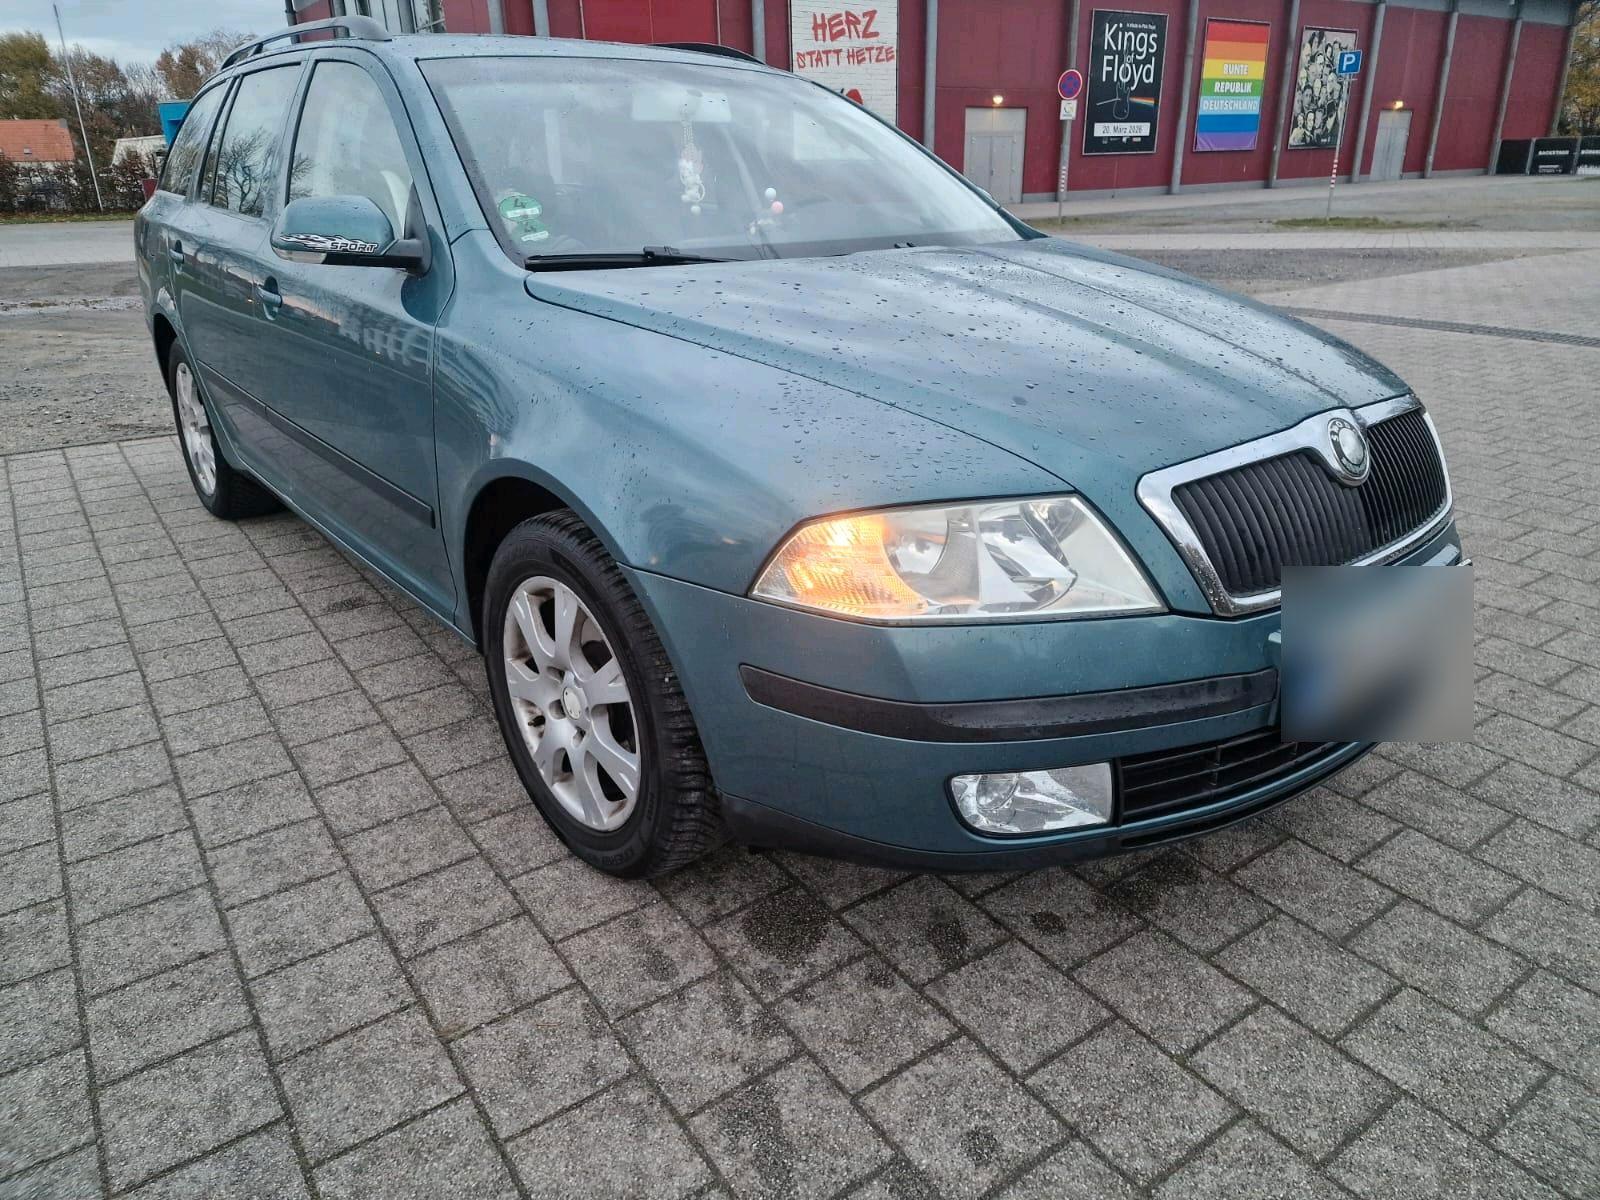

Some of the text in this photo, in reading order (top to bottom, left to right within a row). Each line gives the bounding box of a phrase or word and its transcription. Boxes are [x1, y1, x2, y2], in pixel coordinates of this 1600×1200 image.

[812, 9, 880, 42] HERZ
[1104, 22, 1158, 60] Kings
[796, 45, 895, 68] STATT HETZE
[1126, 53, 1134, 64] of
[1342, 54, 1356, 67] P
[1102, 54, 1155, 91] Floyd
[1223, 63, 1249, 75] BUNTE
[1214, 81, 1253, 93] REPUBLIK
[1202, 99, 1258, 111] DEUTSCHLAND
[330, 241, 378, 253] SPORT
